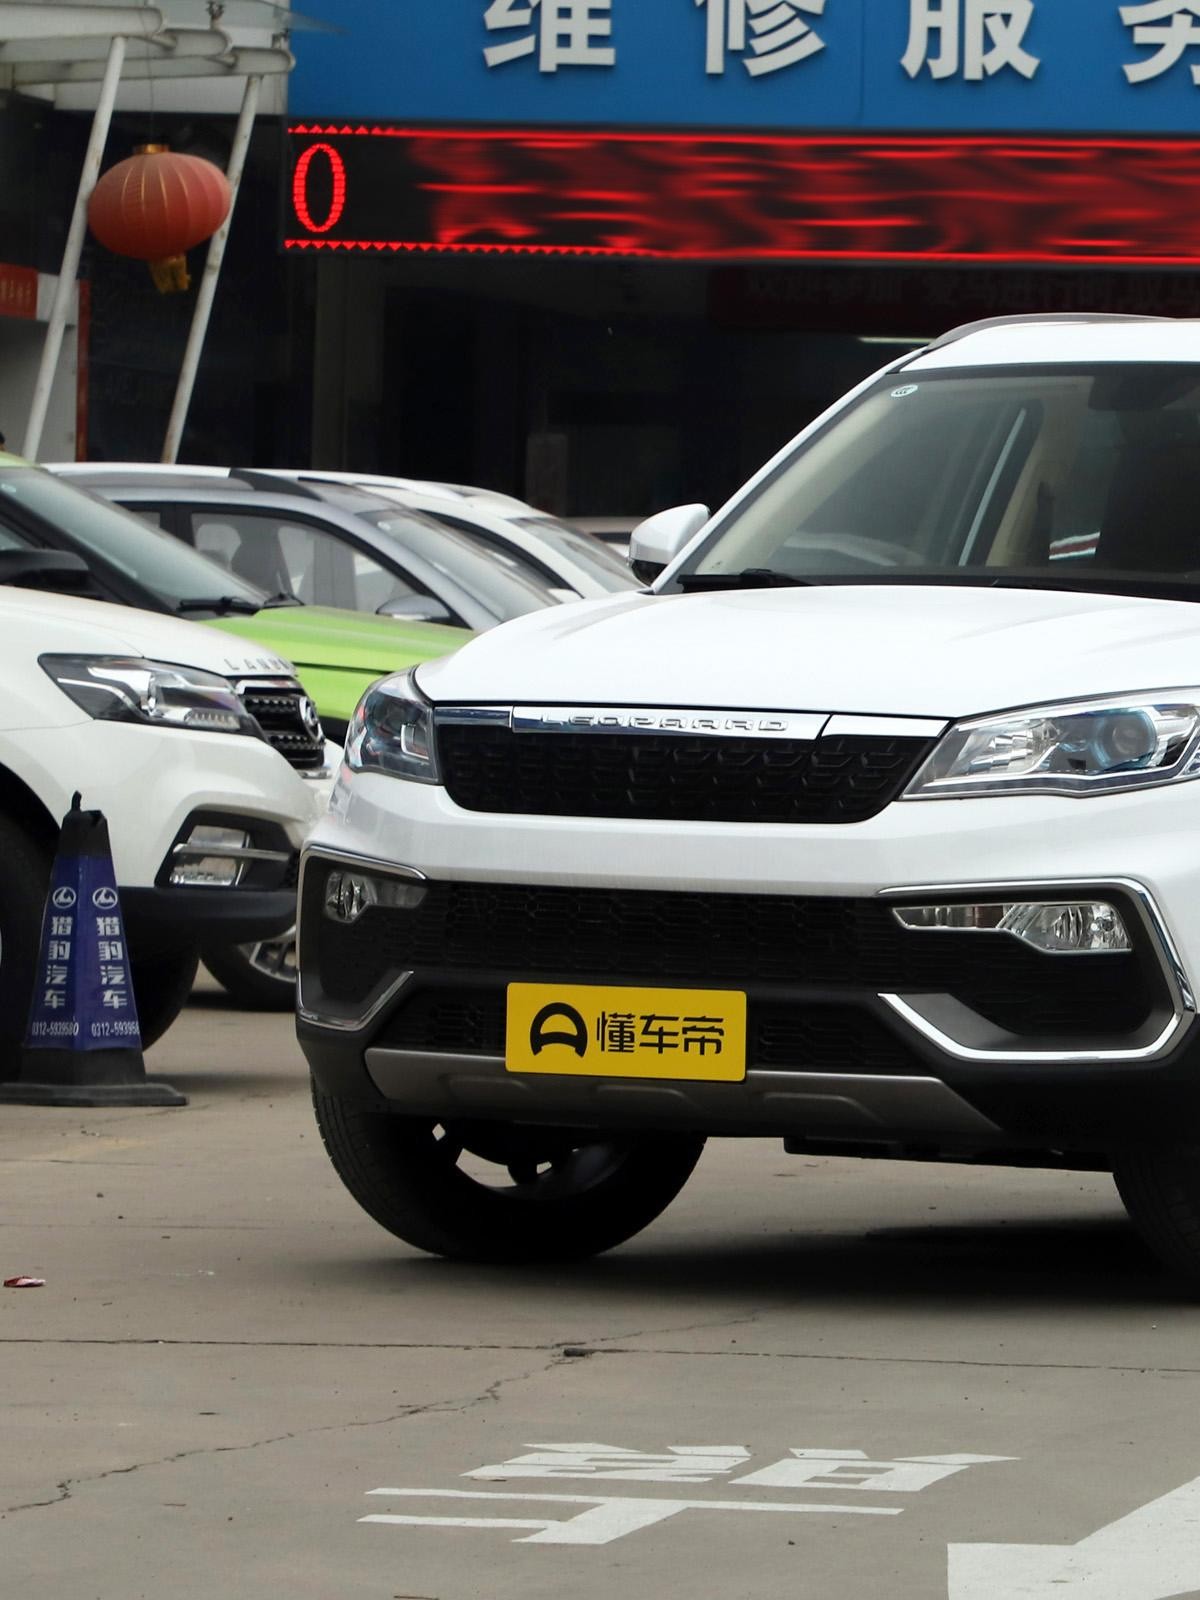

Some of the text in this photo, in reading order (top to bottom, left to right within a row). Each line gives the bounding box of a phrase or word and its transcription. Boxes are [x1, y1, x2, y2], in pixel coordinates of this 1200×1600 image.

[540, 711, 788, 732] LEOPAARD
[45, 916, 74, 1009] 猎豹汽车
[96, 916, 128, 1009] 猎豹汽车
[596, 1010, 725, 1056] 懂车帝
